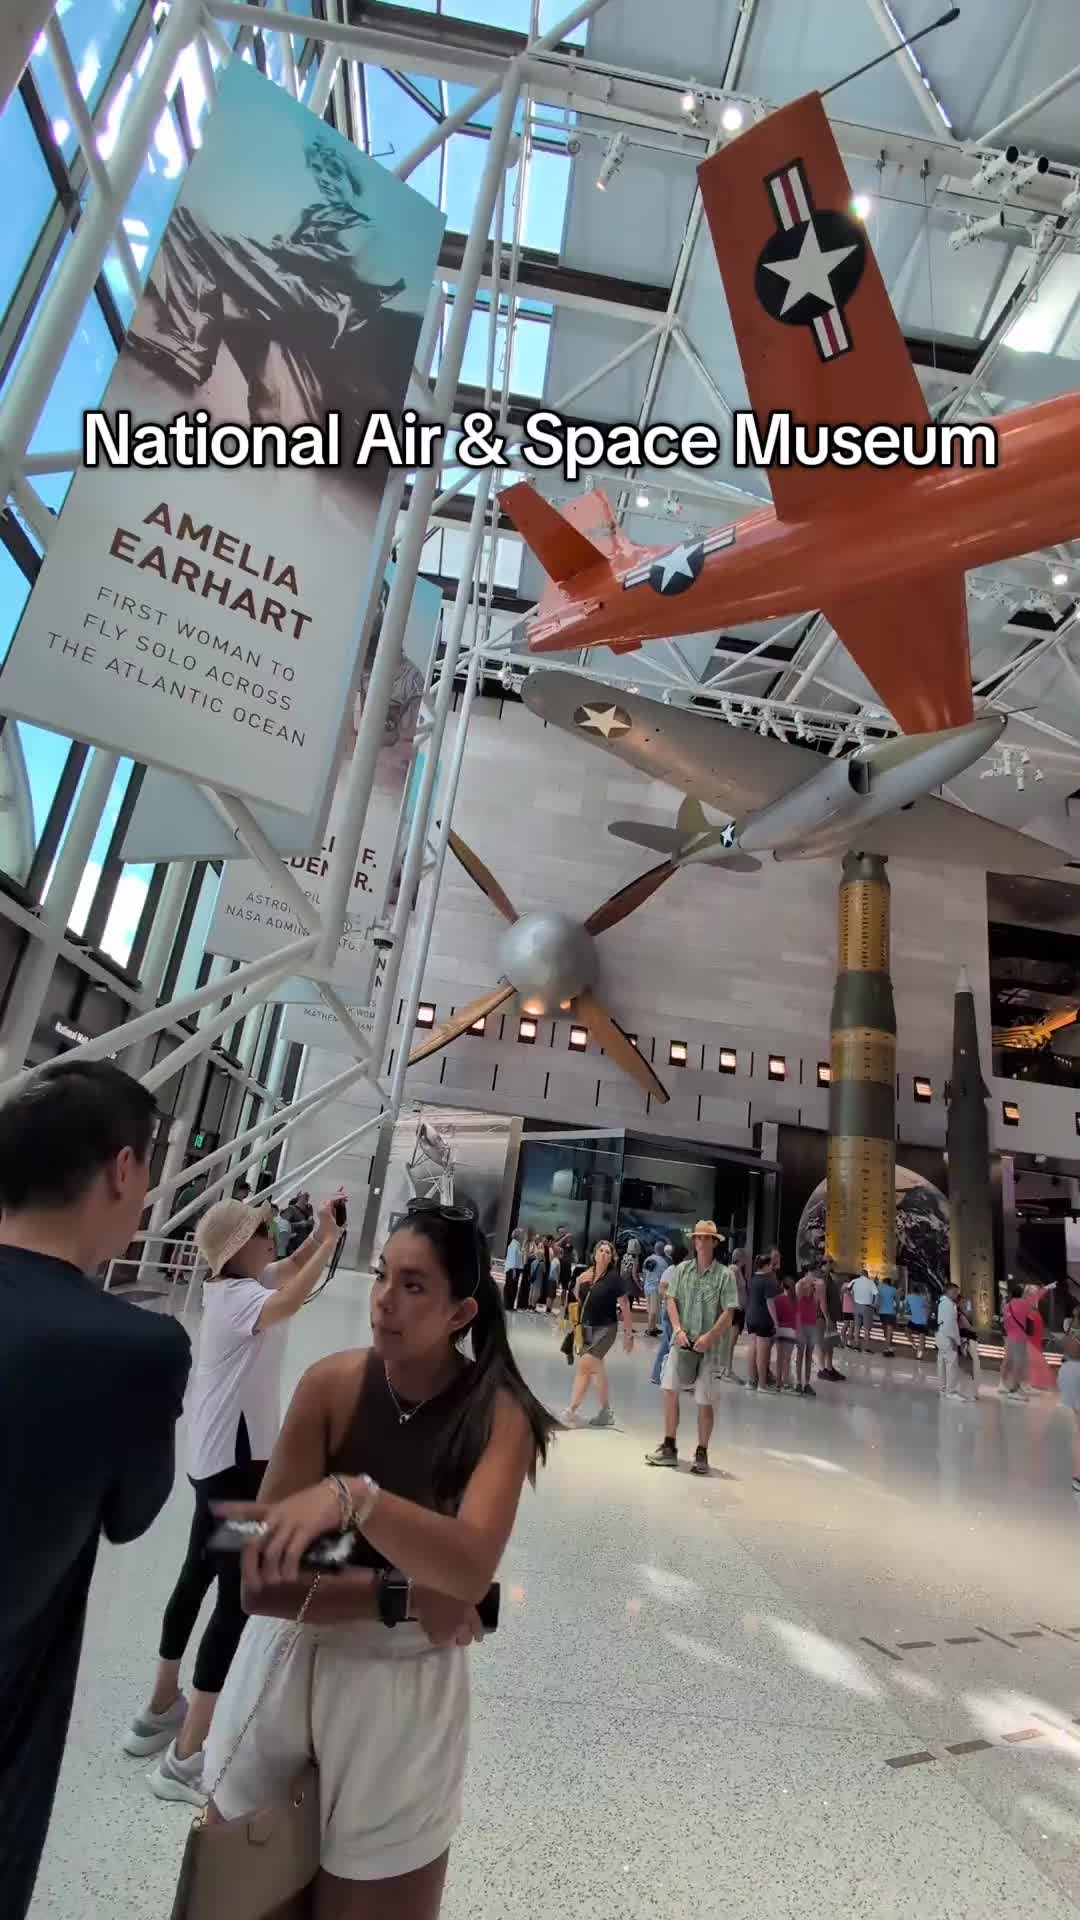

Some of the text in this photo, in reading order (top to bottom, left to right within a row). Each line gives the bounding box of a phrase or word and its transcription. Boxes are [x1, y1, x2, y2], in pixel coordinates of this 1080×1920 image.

[108, 527, 313, 640] EARHART
[142, 501, 300, 596] AMELIA
[82, 613, 293, 712] FLY SOLO ACROSS
[96, 585, 296, 683] FIRST WOMAN TO
[46, 632, 306, 748] THE ATLANTIC OCEAN
[225, 905, 261, 922] NASA
